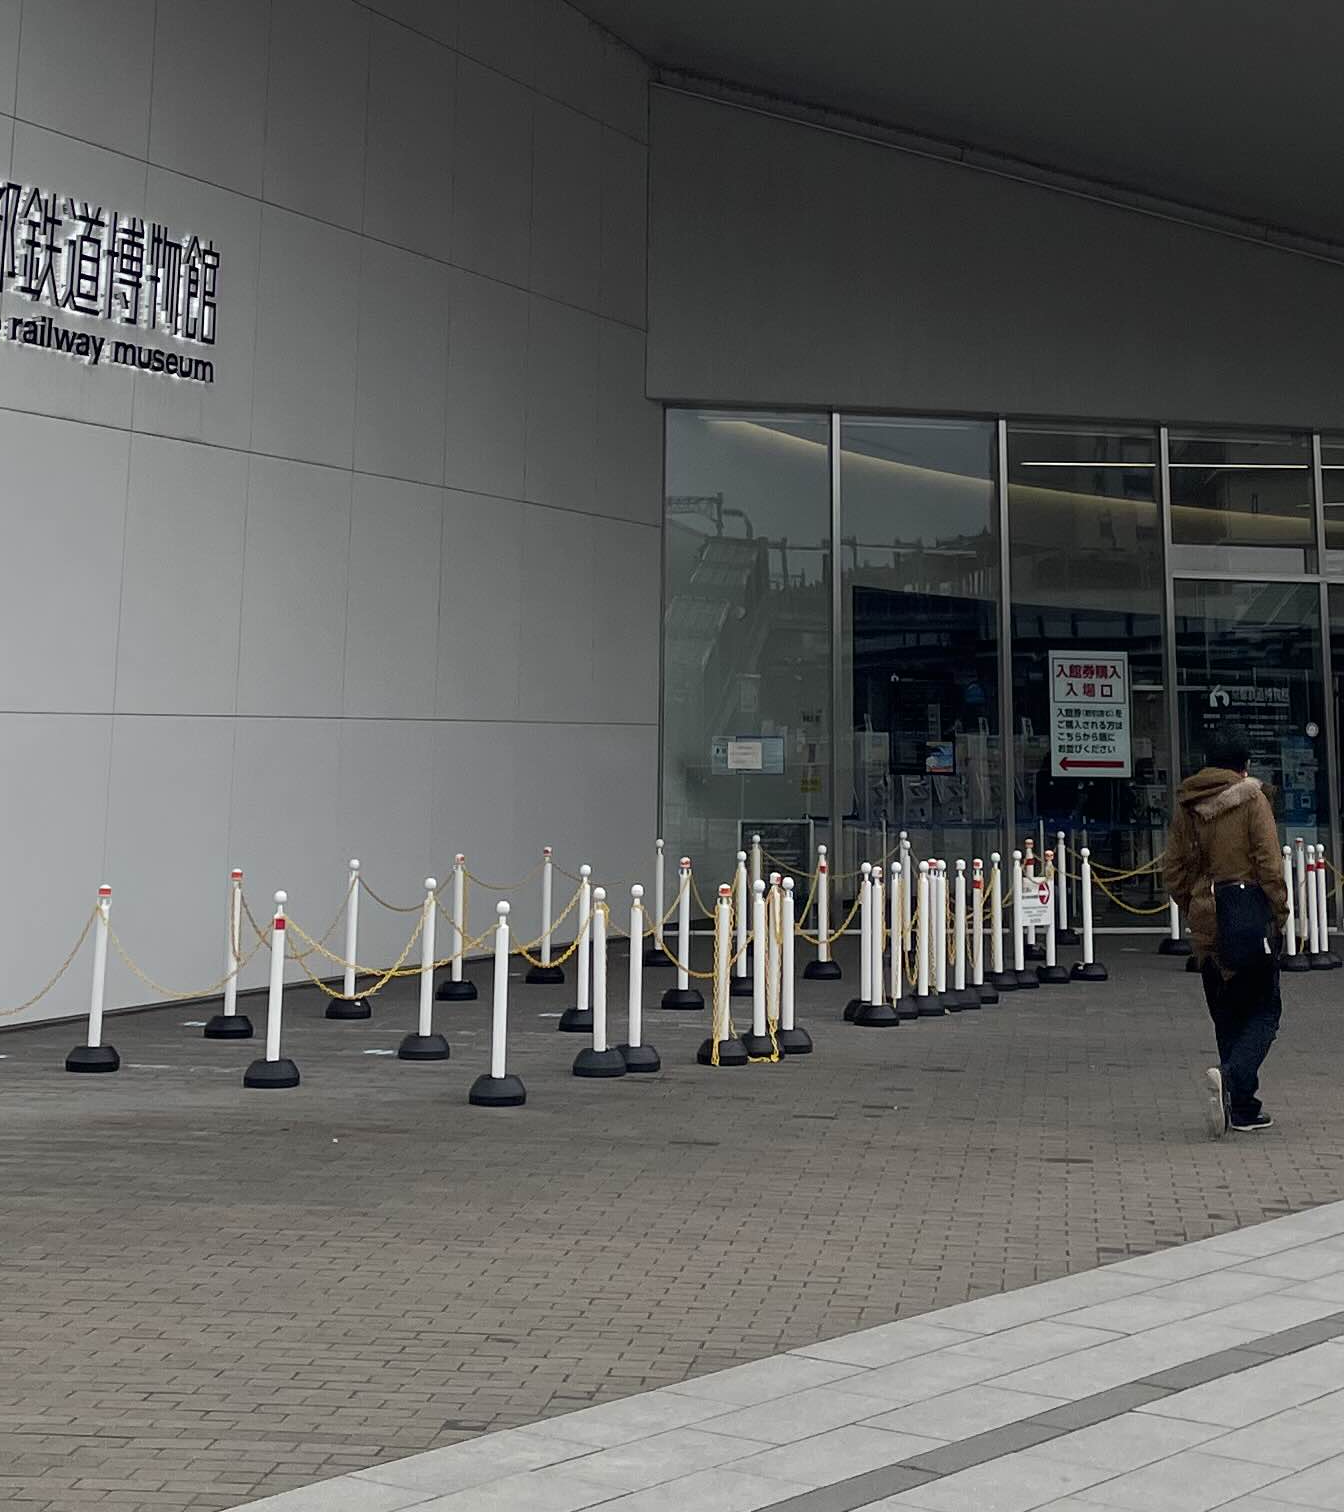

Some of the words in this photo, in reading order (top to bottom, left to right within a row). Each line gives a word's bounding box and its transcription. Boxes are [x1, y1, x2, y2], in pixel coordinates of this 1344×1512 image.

[9, 317, 105, 365] railway
[113, 340, 215, 384] museum
[1056, 664, 1121, 679] 入館券購入
[1066, 683, 1113, 697] 入場口
[1058, 744, 1116, 754] お並びください
